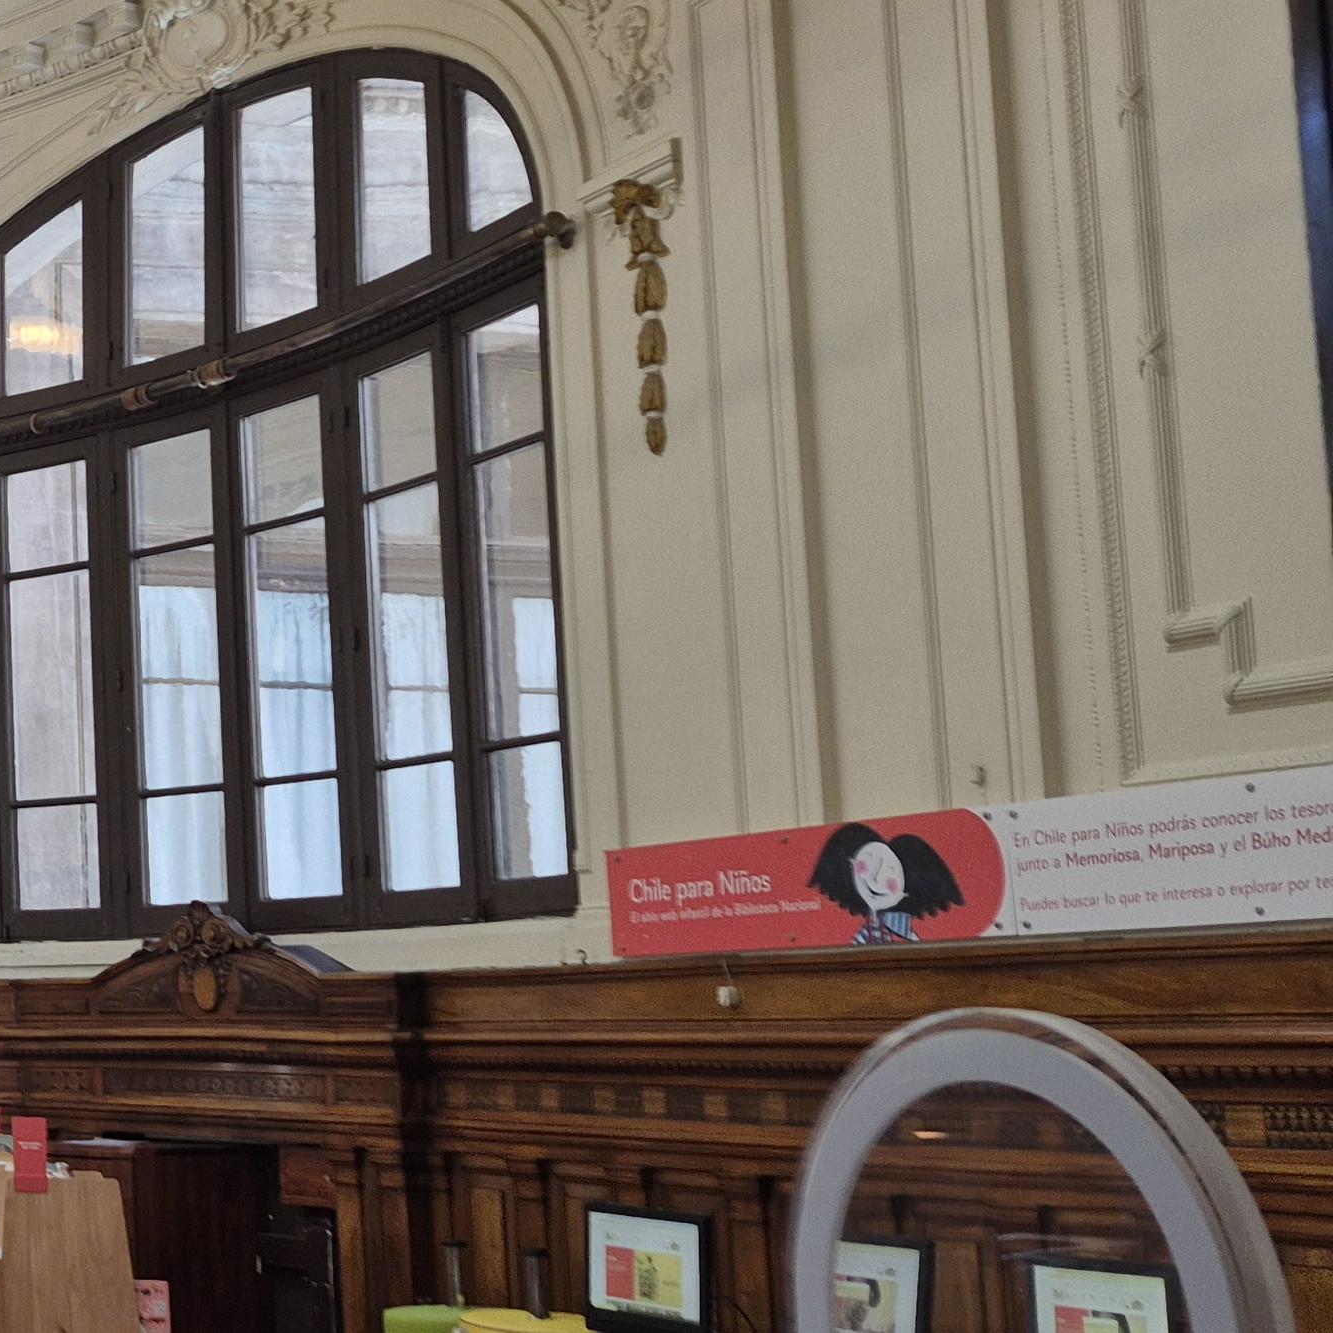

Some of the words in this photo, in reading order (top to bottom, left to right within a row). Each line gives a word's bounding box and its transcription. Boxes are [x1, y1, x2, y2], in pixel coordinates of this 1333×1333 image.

[1014, 832, 1030, 848] En
[1034, 829, 1067, 846] Chile
[1071, 828, 1101, 845] para
[1105, 821, 1144, 839] Niños
[1149, 814, 1197, 839] podrás
[1201, 811, 1259, 829] conocer
[1264, 805, 1285, 821] los
[1017, 857, 1049, 877] junto
[1053, 858, 1061, 869] a
[1065, 848, 1144, 868] Memoriosa,
[1148, 841, 1215, 861] Mariposa
[1220, 841, 1227, 858] y
[1234, 834, 1247, 851] el
[1251, 829, 1291, 850] Búho
[629, 877, 672, 905] Chile
[676, 879, 714, 907] para
[718, 869, 772, 896] Niños
[1020, 896, 1059, 913] Puedes
[1063, 894, 1100, 909] buscar
[1105, 891, 1116, 905] lo
[1119, 892, 1141, 908] que
[1146, 890, 1159, 902] te
[1163, 884, 1213, 901] interesa
[1218, 885, 1225, 897] o
[1230, 880, 1282, 899] explorar
[1288, 878, 1310, 895] por
